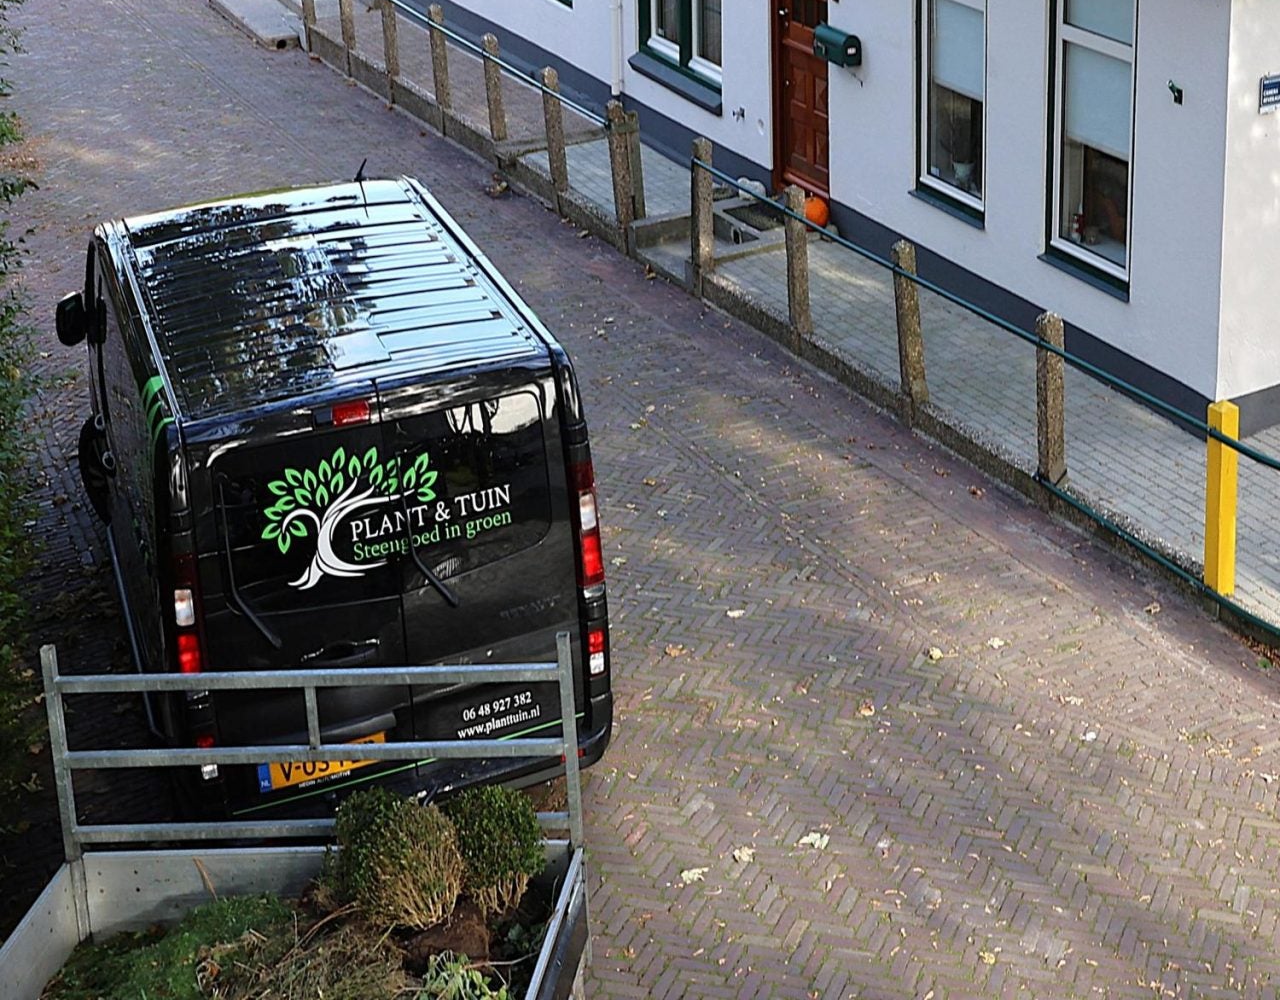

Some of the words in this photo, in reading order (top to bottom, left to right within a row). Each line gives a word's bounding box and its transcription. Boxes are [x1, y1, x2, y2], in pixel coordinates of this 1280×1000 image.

[350, 505, 428, 542] PLANT
[435, 501, 451, 522] &
[454, 484, 511, 516] TUIN
[445, 522, 462, 540] in
[465, 511, 512, 539] groen
[457, 704, 540, 739] www.planttuin.nl
[463, 707, 476, 721] 06
[478, 703, 491, 717] 48
[493, 697, 511, 713] 927
[513, 691, 532, 707] 382
